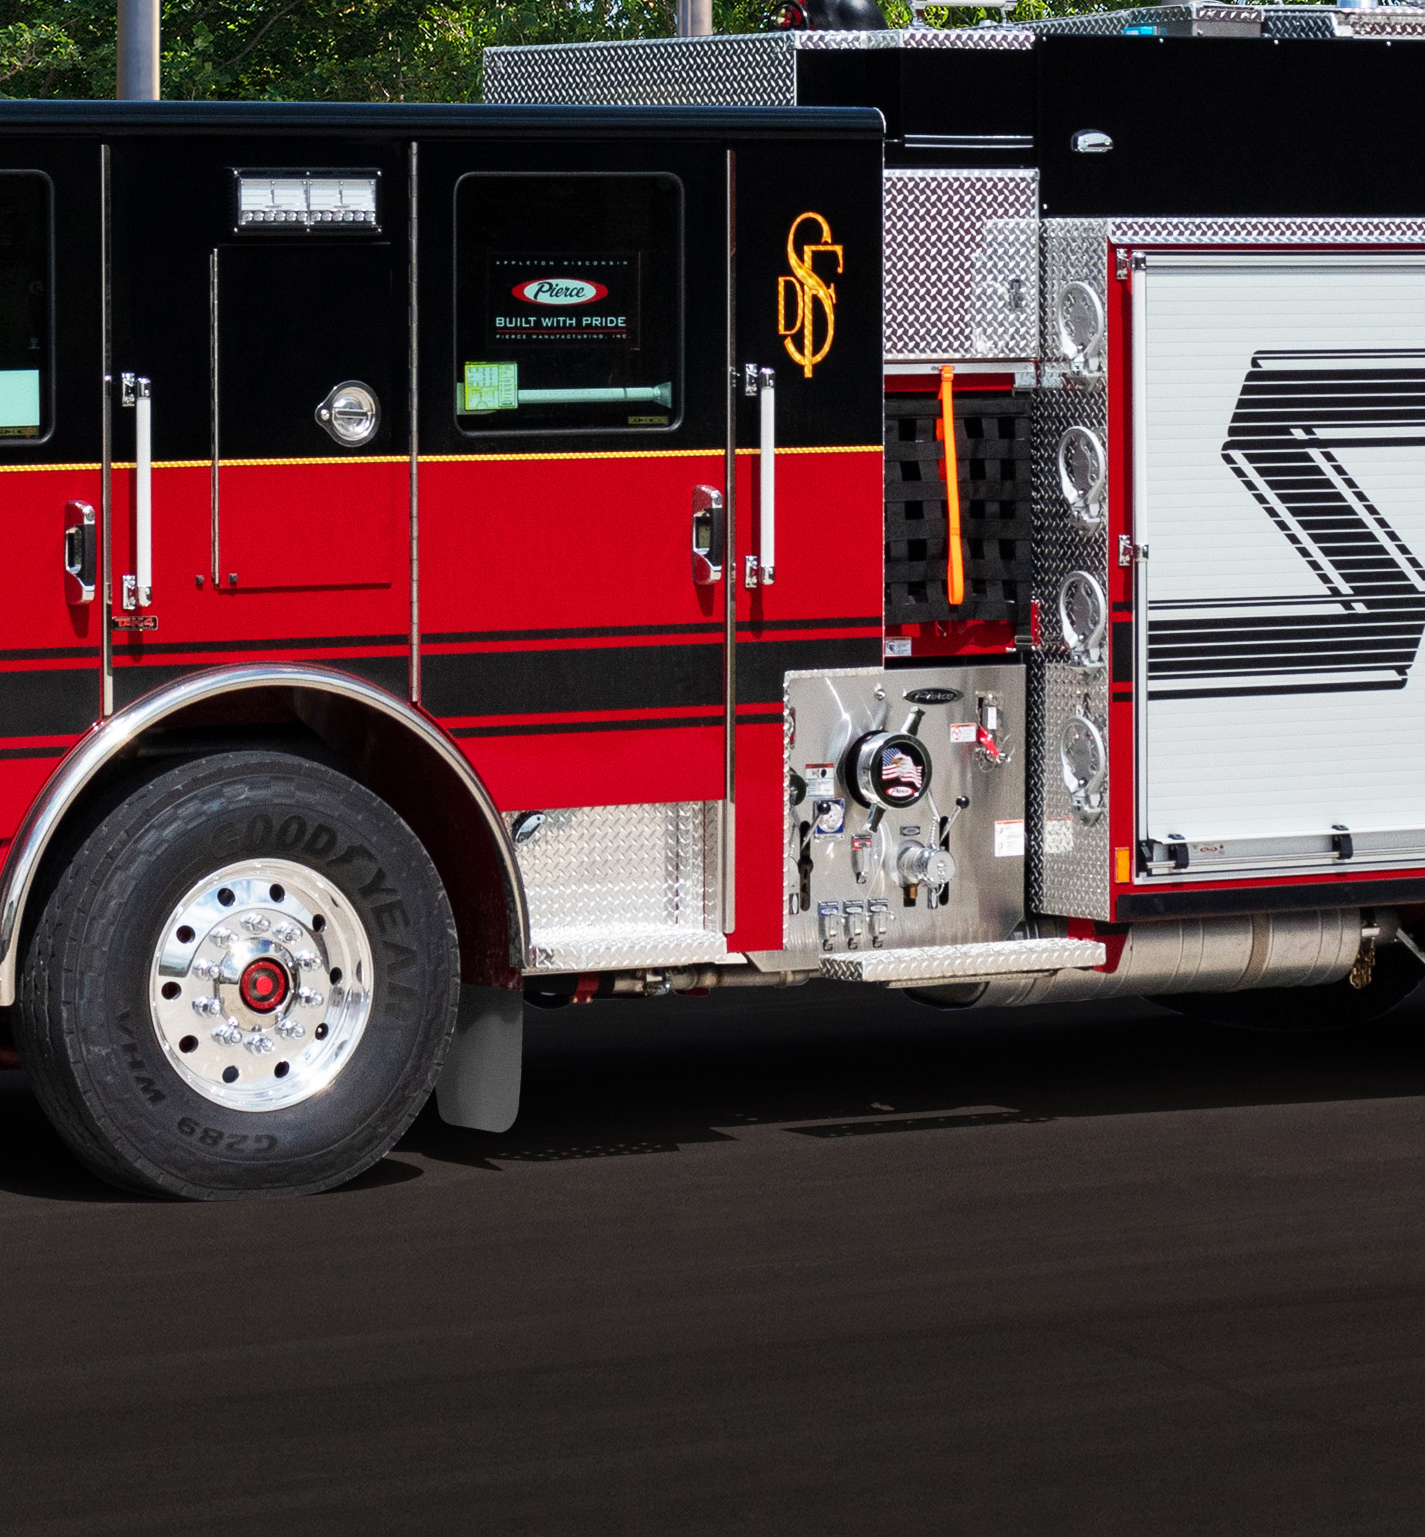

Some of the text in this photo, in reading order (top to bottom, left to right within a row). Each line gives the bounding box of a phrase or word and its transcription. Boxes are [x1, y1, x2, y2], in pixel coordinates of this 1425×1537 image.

[533, 281, 585, 300] Pierce
[496, 317, 627, 327] BUILT WITH PRIDE
[210, 814, 418, 1022] GOODYEAR
[176, 1116, 278, 1153] G289
